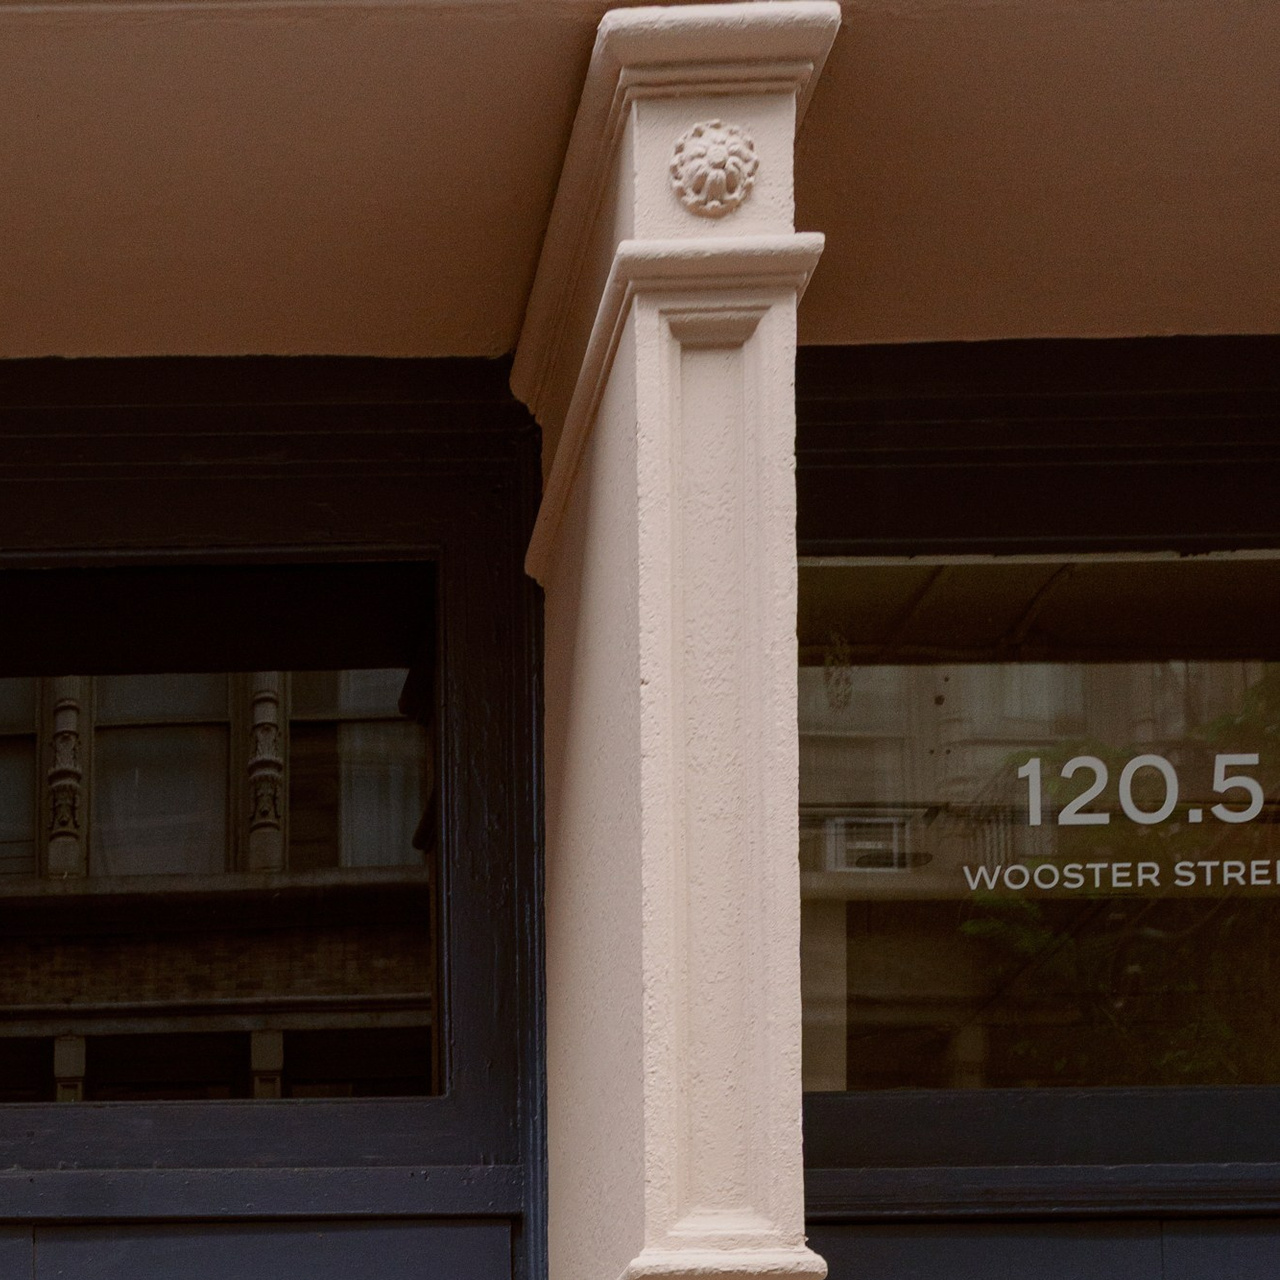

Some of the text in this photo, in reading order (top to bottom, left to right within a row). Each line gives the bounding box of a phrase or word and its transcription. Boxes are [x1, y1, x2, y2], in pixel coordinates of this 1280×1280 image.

[1018, 753, 1264, 826] 120.5
[963, 860, 1280, 890] WOOSTER STRE
